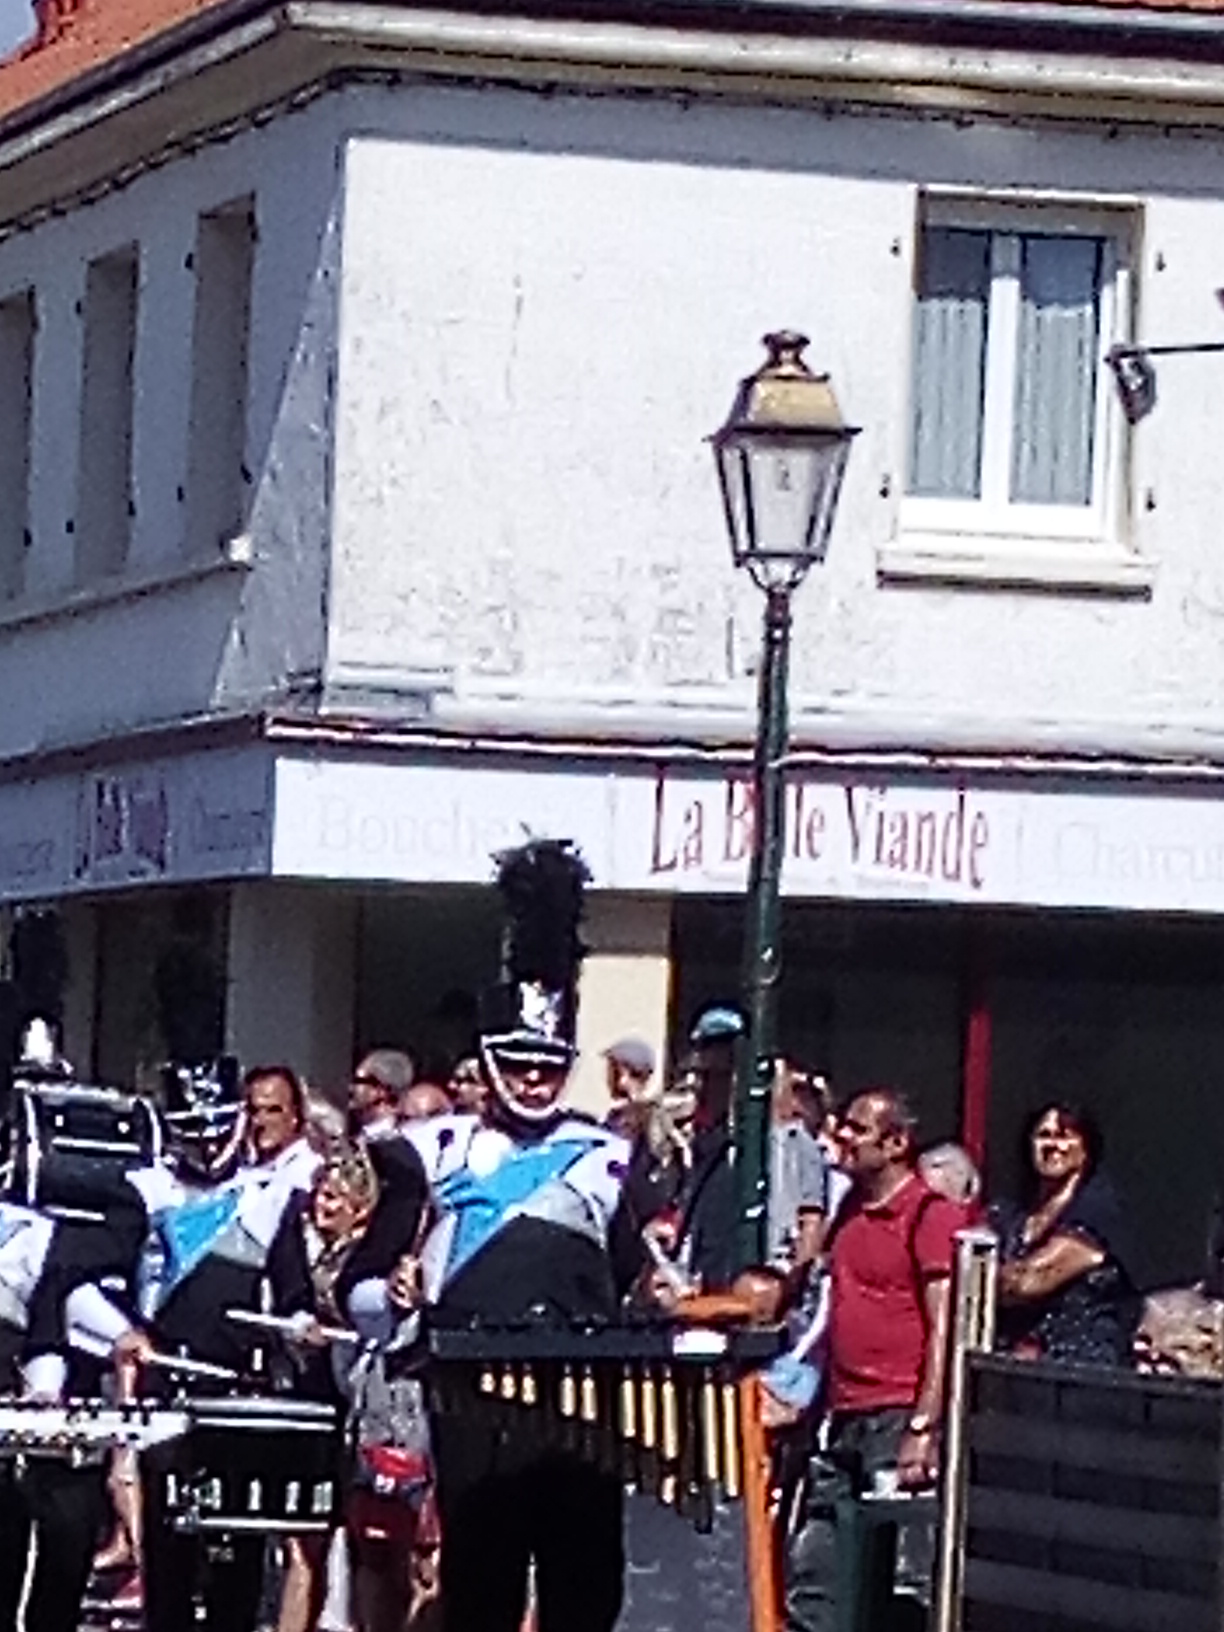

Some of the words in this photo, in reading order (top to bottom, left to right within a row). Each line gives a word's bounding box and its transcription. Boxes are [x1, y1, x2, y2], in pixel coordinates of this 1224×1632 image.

[649, 767, 703, 874] La
[723, 772, 825, 862] Ble
[844, 778, 988, 889] Viande
